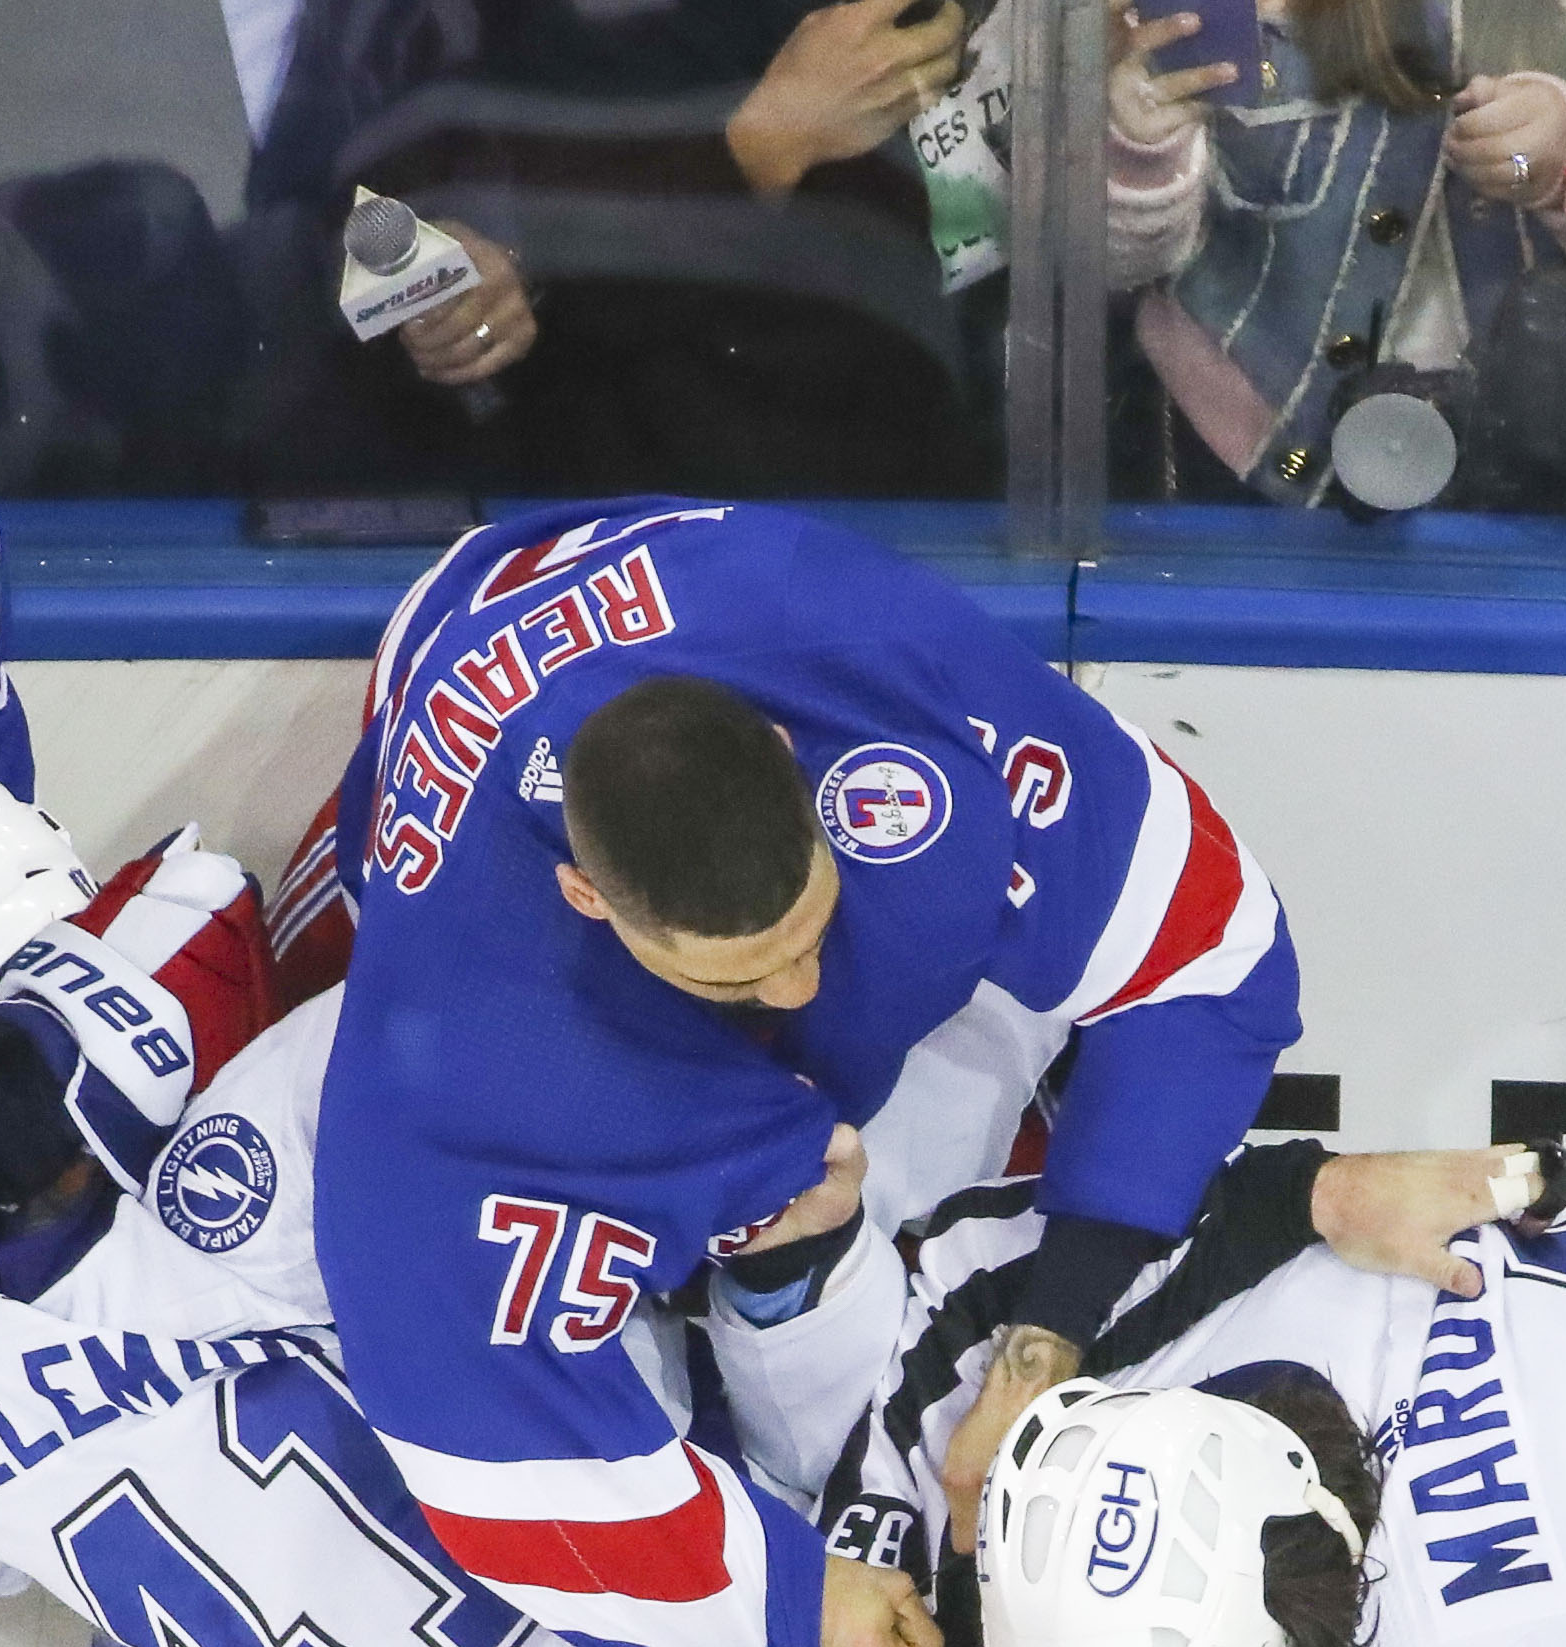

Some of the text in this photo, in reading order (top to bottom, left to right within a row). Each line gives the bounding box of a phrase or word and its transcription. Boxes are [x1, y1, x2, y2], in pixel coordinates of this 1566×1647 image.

[374, 544, 675, 895] REAVES
[518, 736, 551, 802] adidas
[823, 770, 847, 828] RANGER
[1, 938, 191, 1078] BAUE
[159, 1117, 261, 1248] TAMPA BAY LIGHTNING
[477, 1192, 657, 1354] 75
[1402, 1225, 1553, 1607] MARO
[1087, 1461, 1146, 1577] TGH
